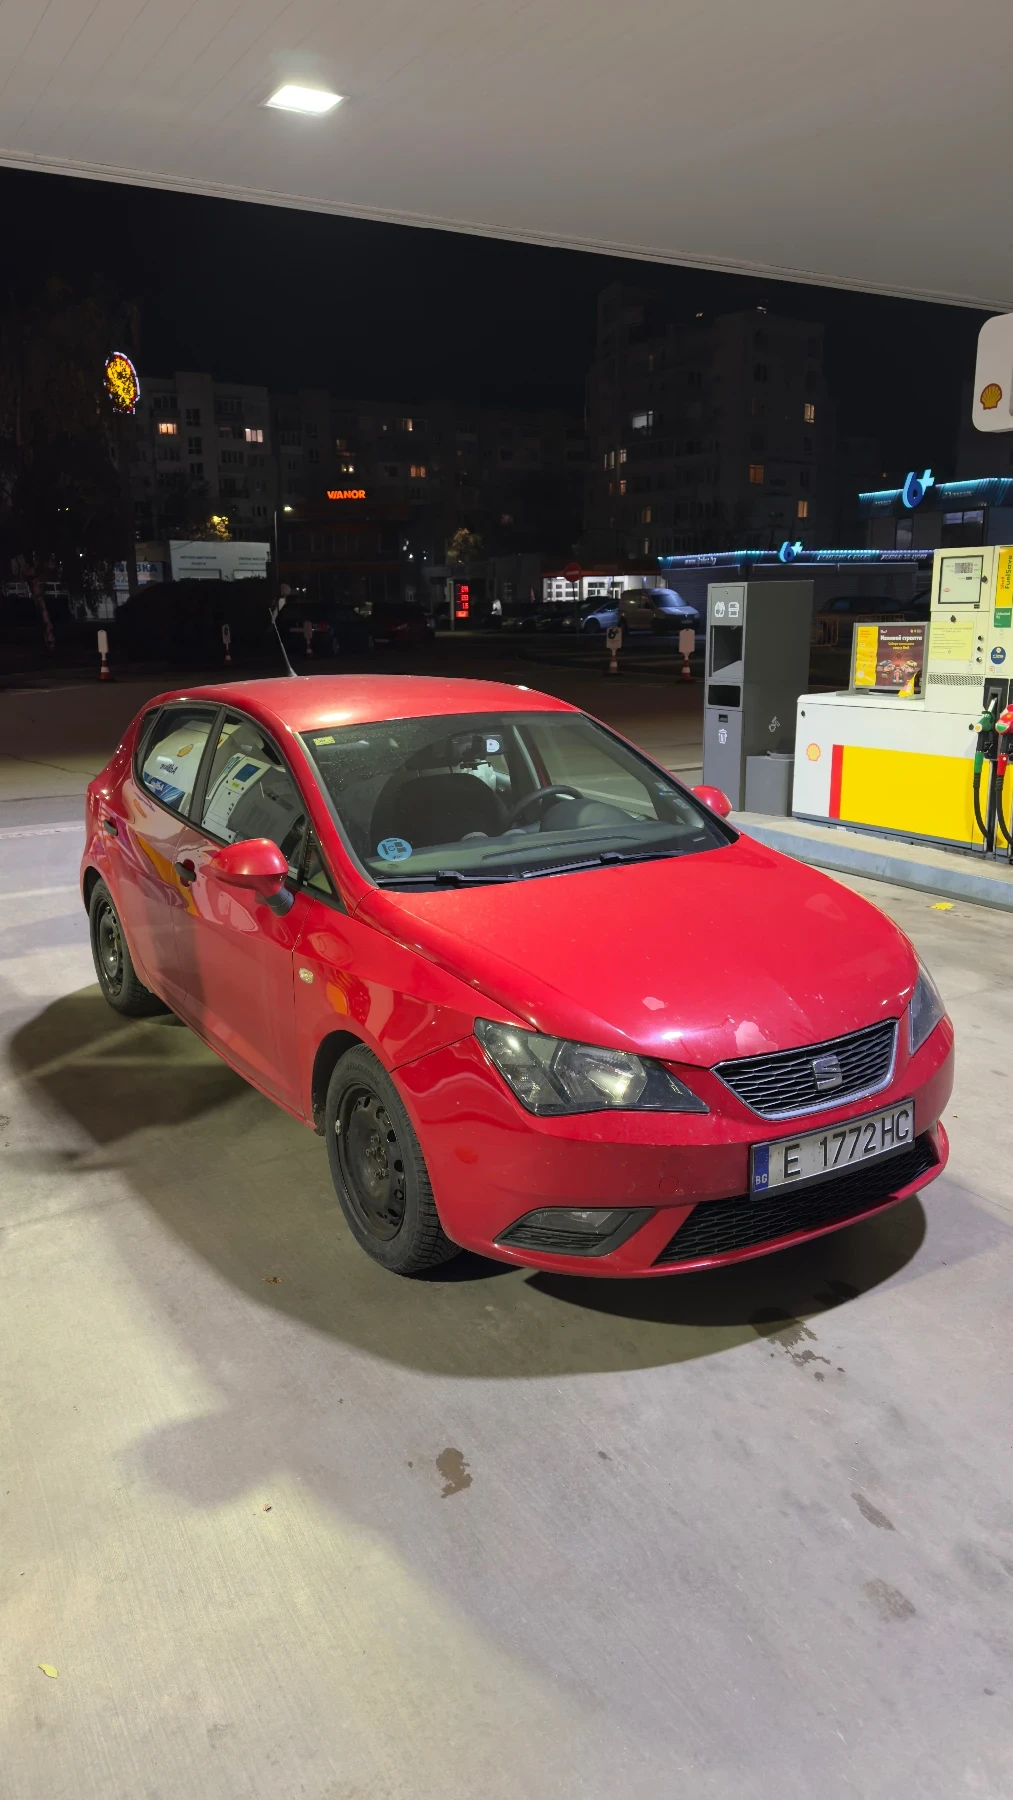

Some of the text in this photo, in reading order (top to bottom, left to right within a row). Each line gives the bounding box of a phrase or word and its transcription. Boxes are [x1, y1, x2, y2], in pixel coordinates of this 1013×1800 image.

[783, 1109, 910, 1179] E 1772 HC
[755, 1172, 769, 1186] BG
